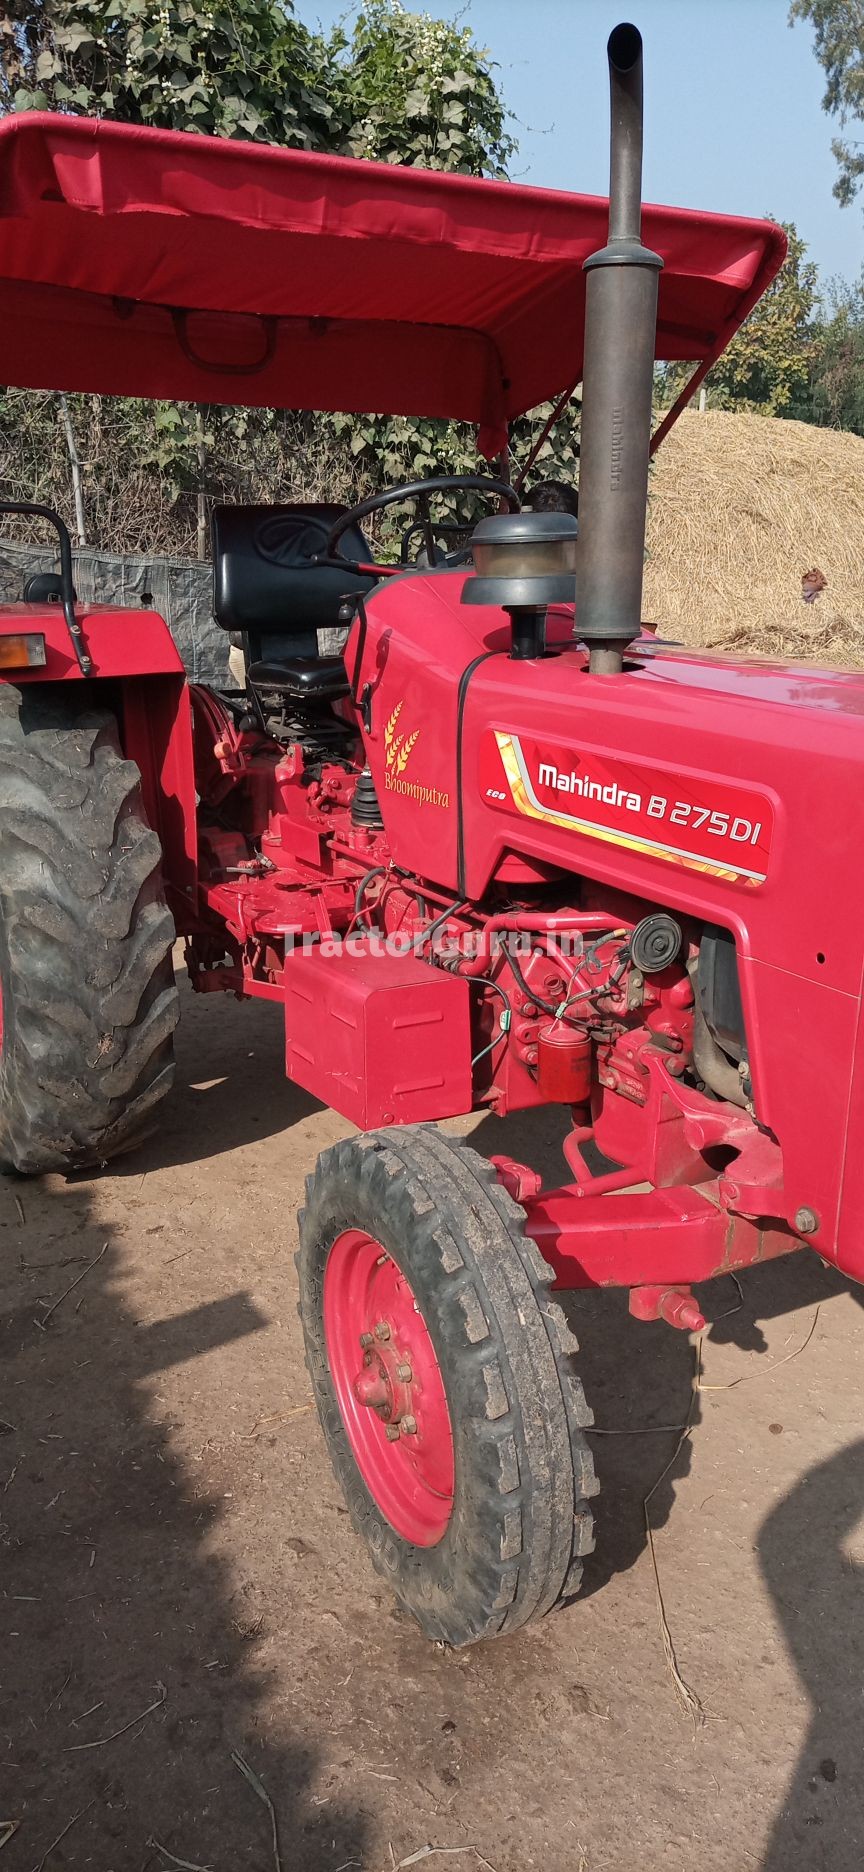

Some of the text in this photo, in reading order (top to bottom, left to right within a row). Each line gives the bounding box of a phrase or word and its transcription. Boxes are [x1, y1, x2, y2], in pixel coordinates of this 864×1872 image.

[384, 771, 449, 808] Bhoomiputra
[485, 788, 507, 800] ECO
[538, 763, 762, 845] Mahindra B 275DI
